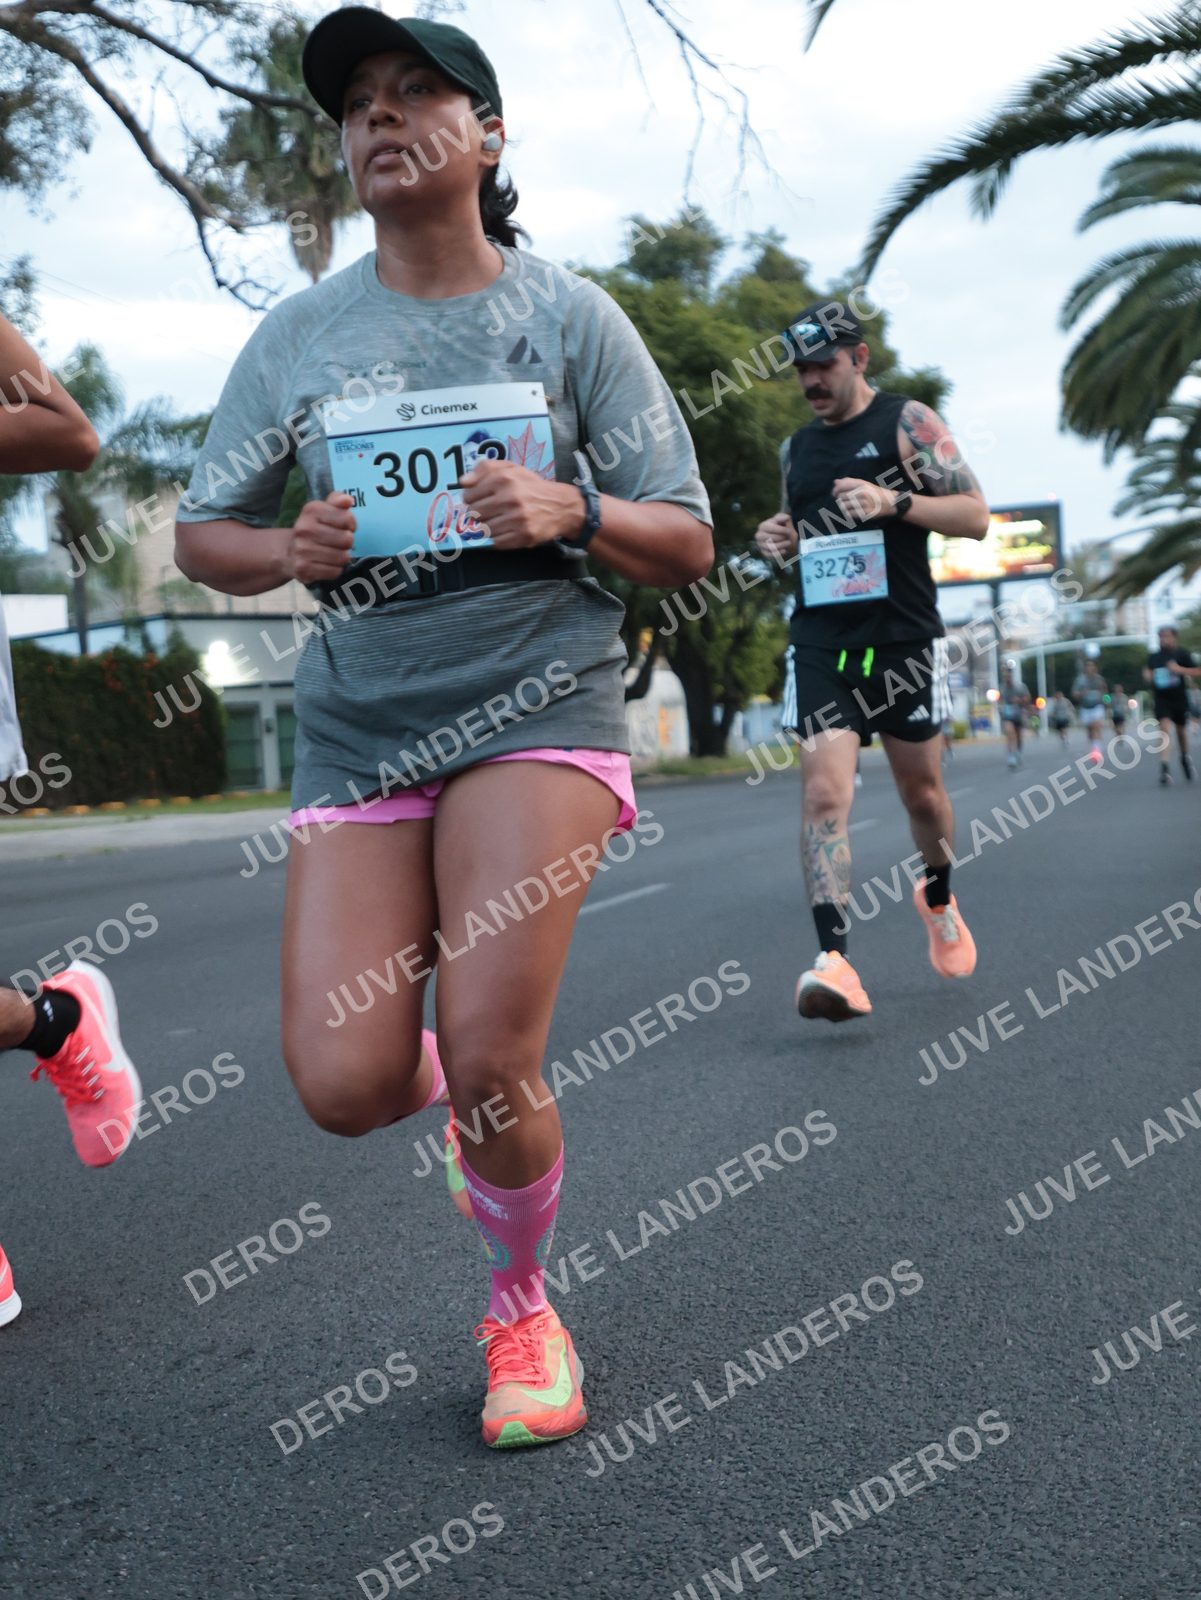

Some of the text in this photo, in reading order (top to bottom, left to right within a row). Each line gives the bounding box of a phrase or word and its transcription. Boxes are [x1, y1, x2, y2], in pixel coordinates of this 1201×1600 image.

[420, 402, 478, 416] Cinemex
[342, 487, 367, 508] 5k
[813, 555, 866, 579] 3275
